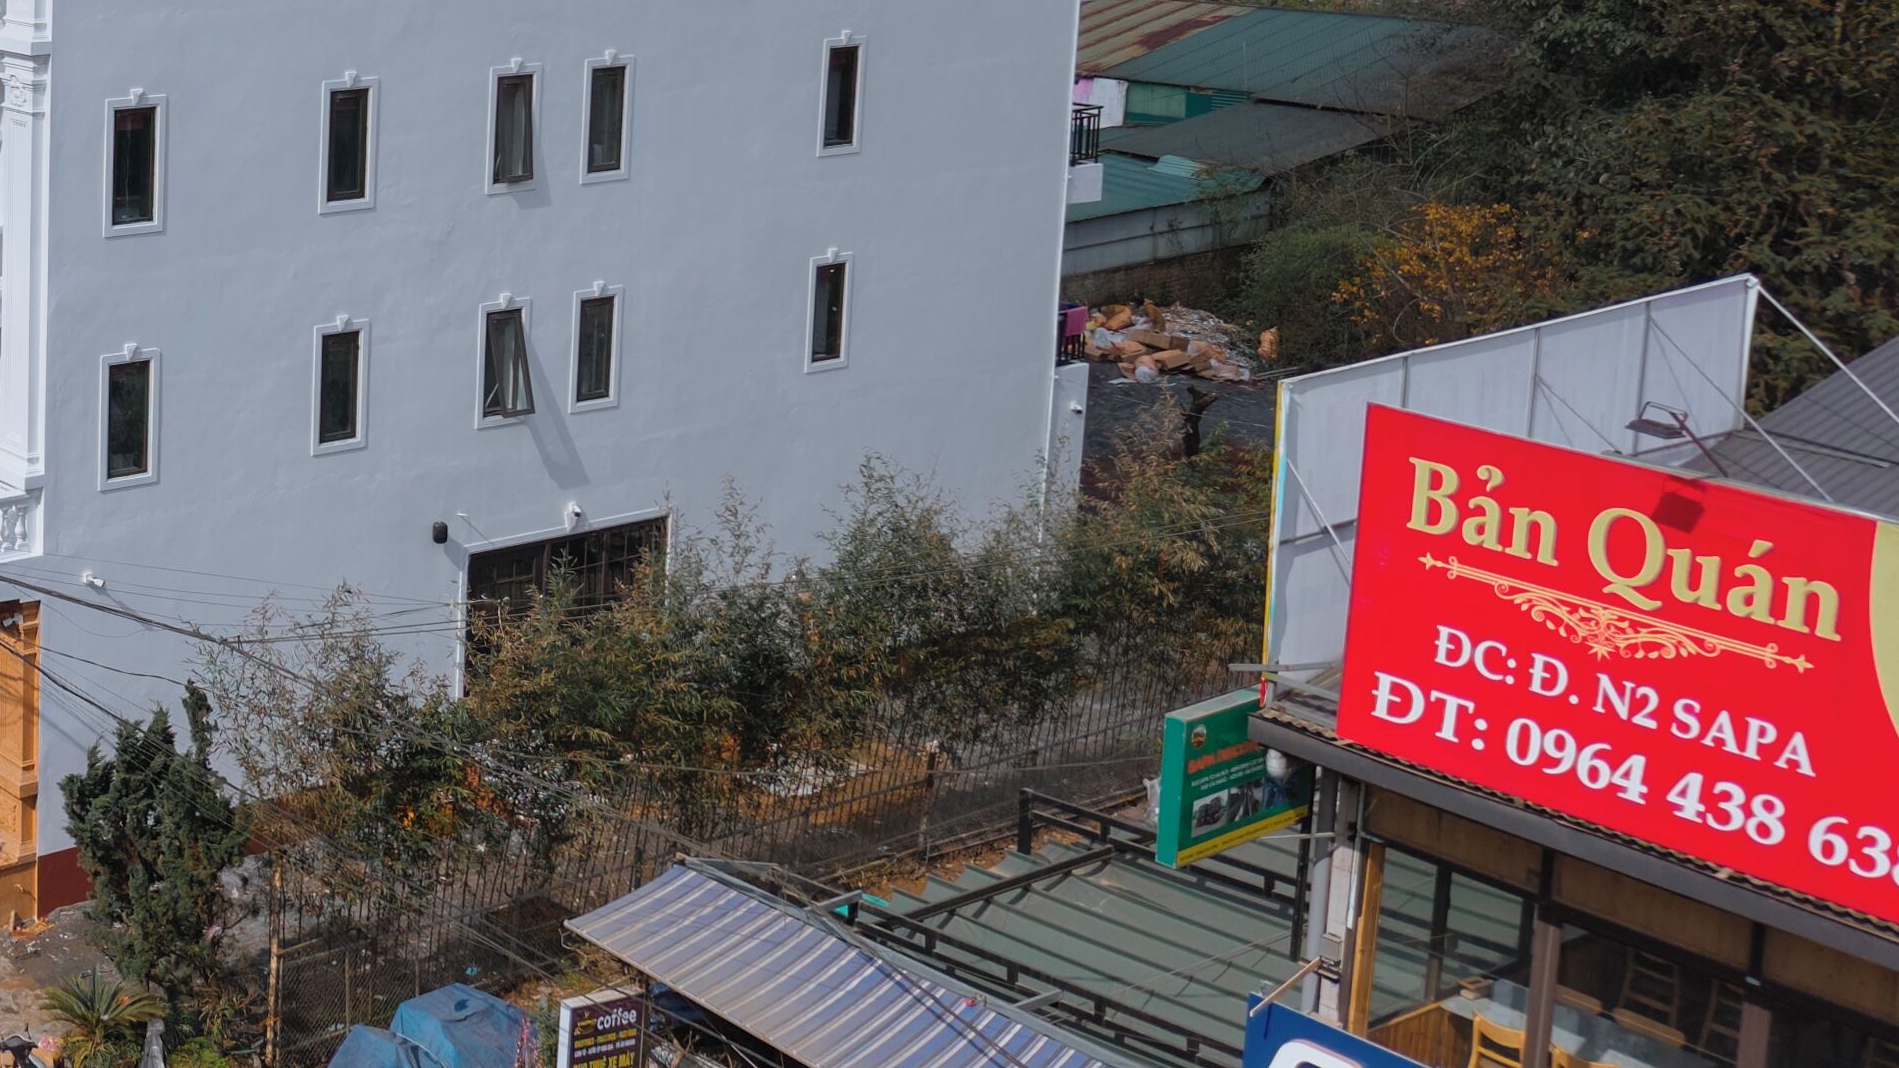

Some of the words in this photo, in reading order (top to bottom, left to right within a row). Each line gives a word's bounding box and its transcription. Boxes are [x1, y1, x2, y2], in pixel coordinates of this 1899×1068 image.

[1406, 456, 1560, 567] Bản
[1587, 507, 1842, 642] Quán
[1371, 672, 1489, 751] ĐT:
[1505, 717, 1650, 805] 0964
[1666, 771, 1787, 846] 438
[1807, 816, 1899, 890] 63
[1434, 625, 1517, 685] ĐC:
[1529, 652, 1580, 706] Đ.
[1593, 673, 1659, 730] N2
[1671, 698, 1817, 778] SAPA
[597, 1008, 637, 1030] coffee
